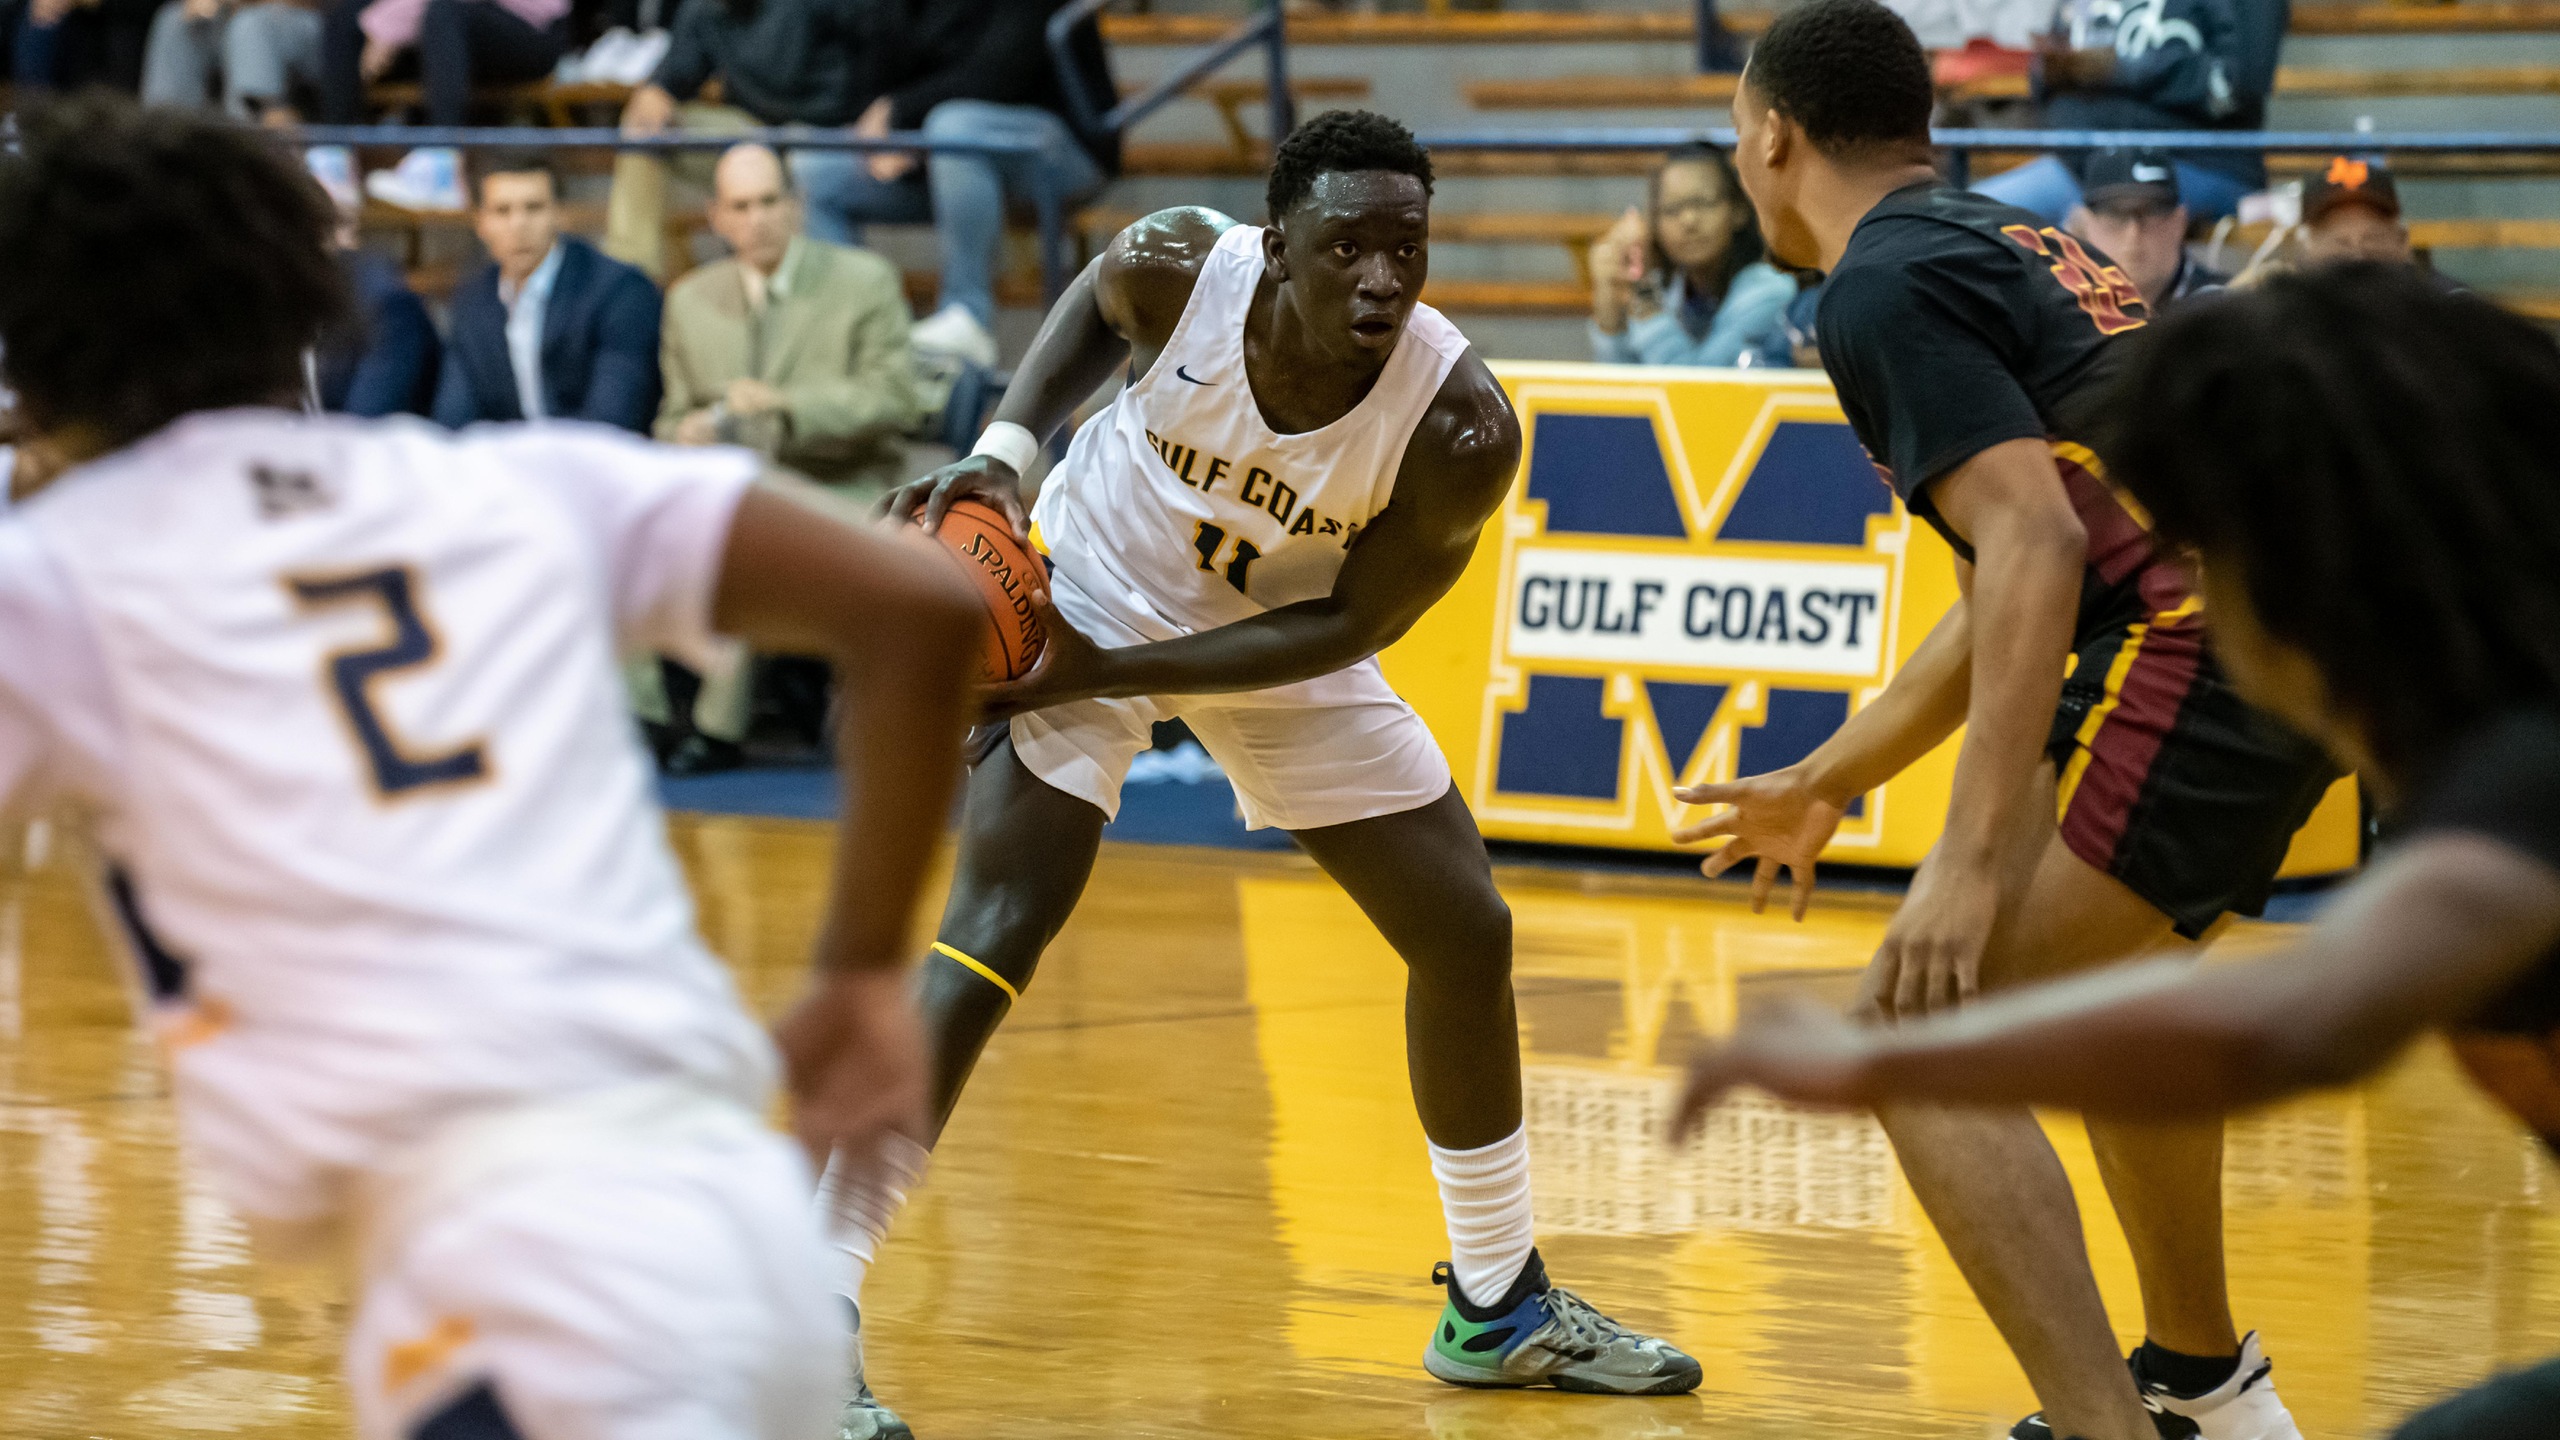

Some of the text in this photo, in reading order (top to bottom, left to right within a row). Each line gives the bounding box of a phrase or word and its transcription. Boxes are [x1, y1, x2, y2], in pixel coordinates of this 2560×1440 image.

[960, 532, 1042, 664] SPALDING
[1194, 519, 1262, 594] 11
[1519, 574, 1877, 649] GULF COAST
[276, 562, 492, 806] 2
